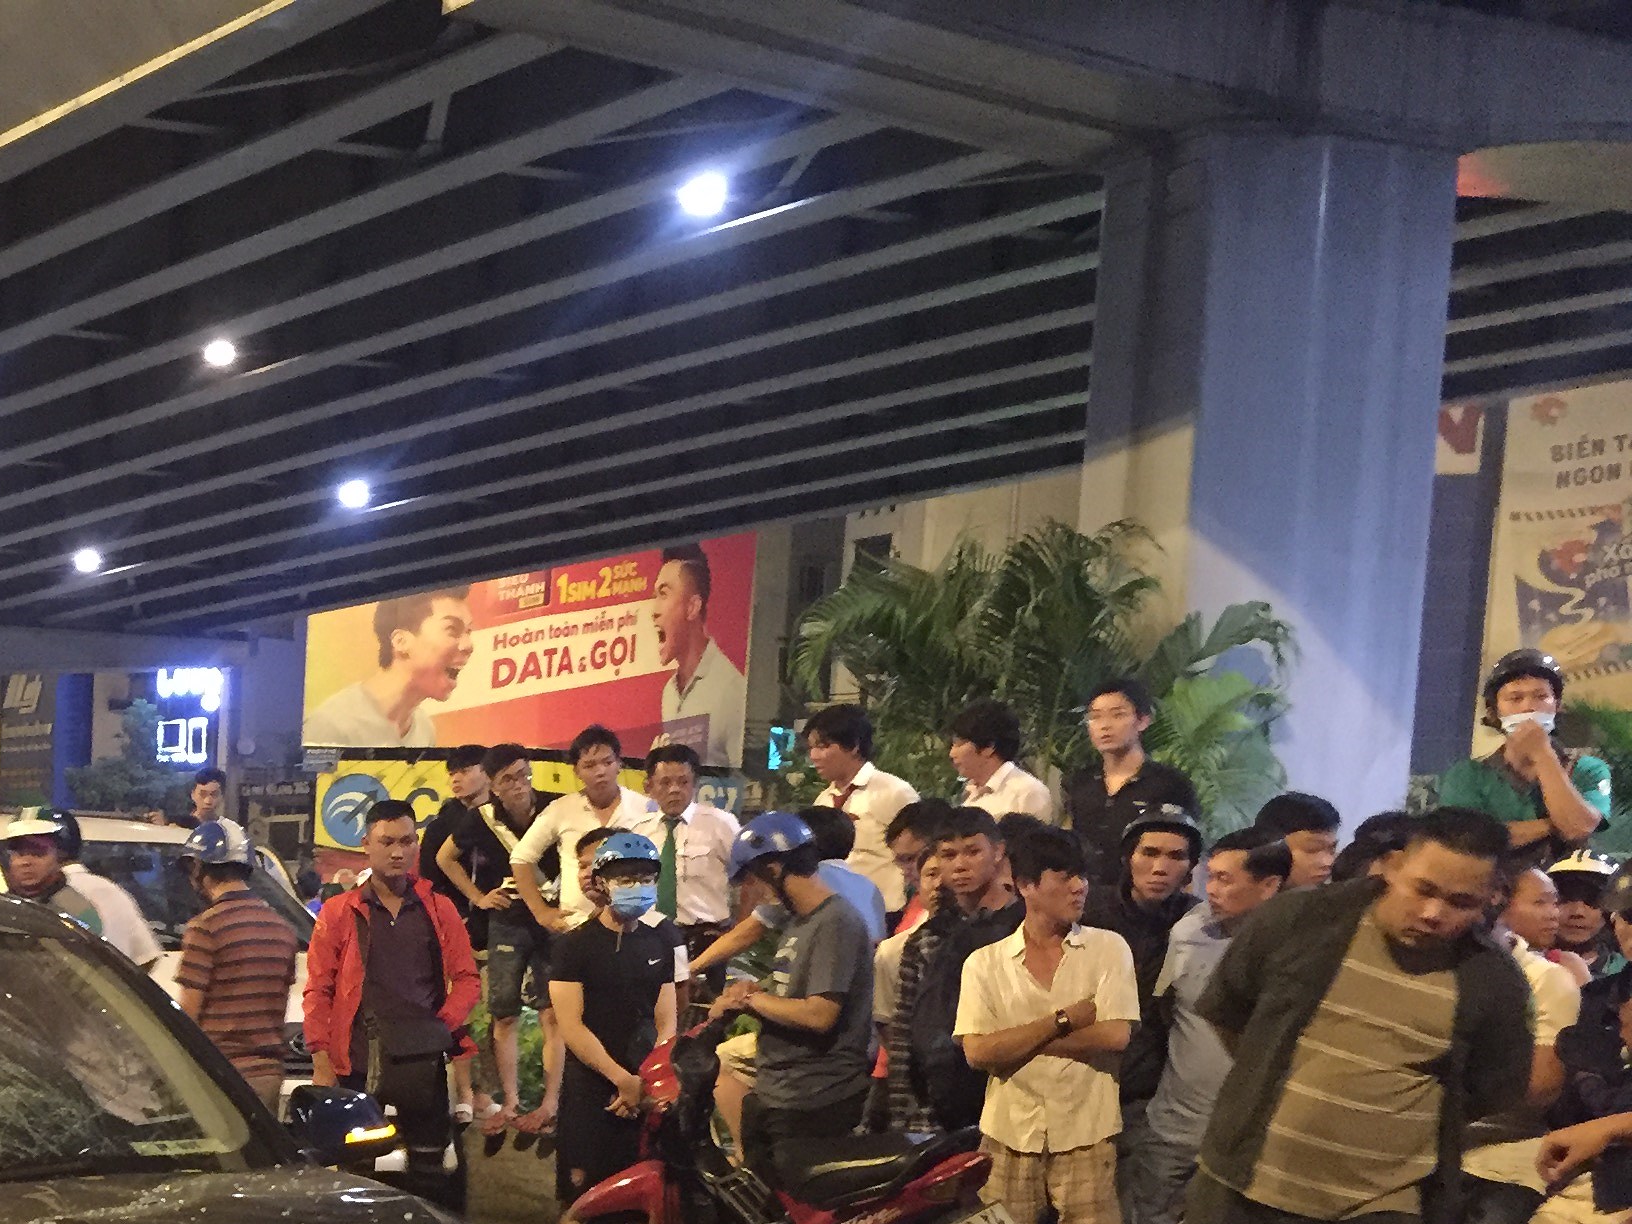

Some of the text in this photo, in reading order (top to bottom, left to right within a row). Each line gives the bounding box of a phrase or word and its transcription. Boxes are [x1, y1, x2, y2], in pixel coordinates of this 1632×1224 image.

[493, 608, 640, 651] Hoàn toàn miễn phí
[491, 634, 637, 689] DATA & GỌI
